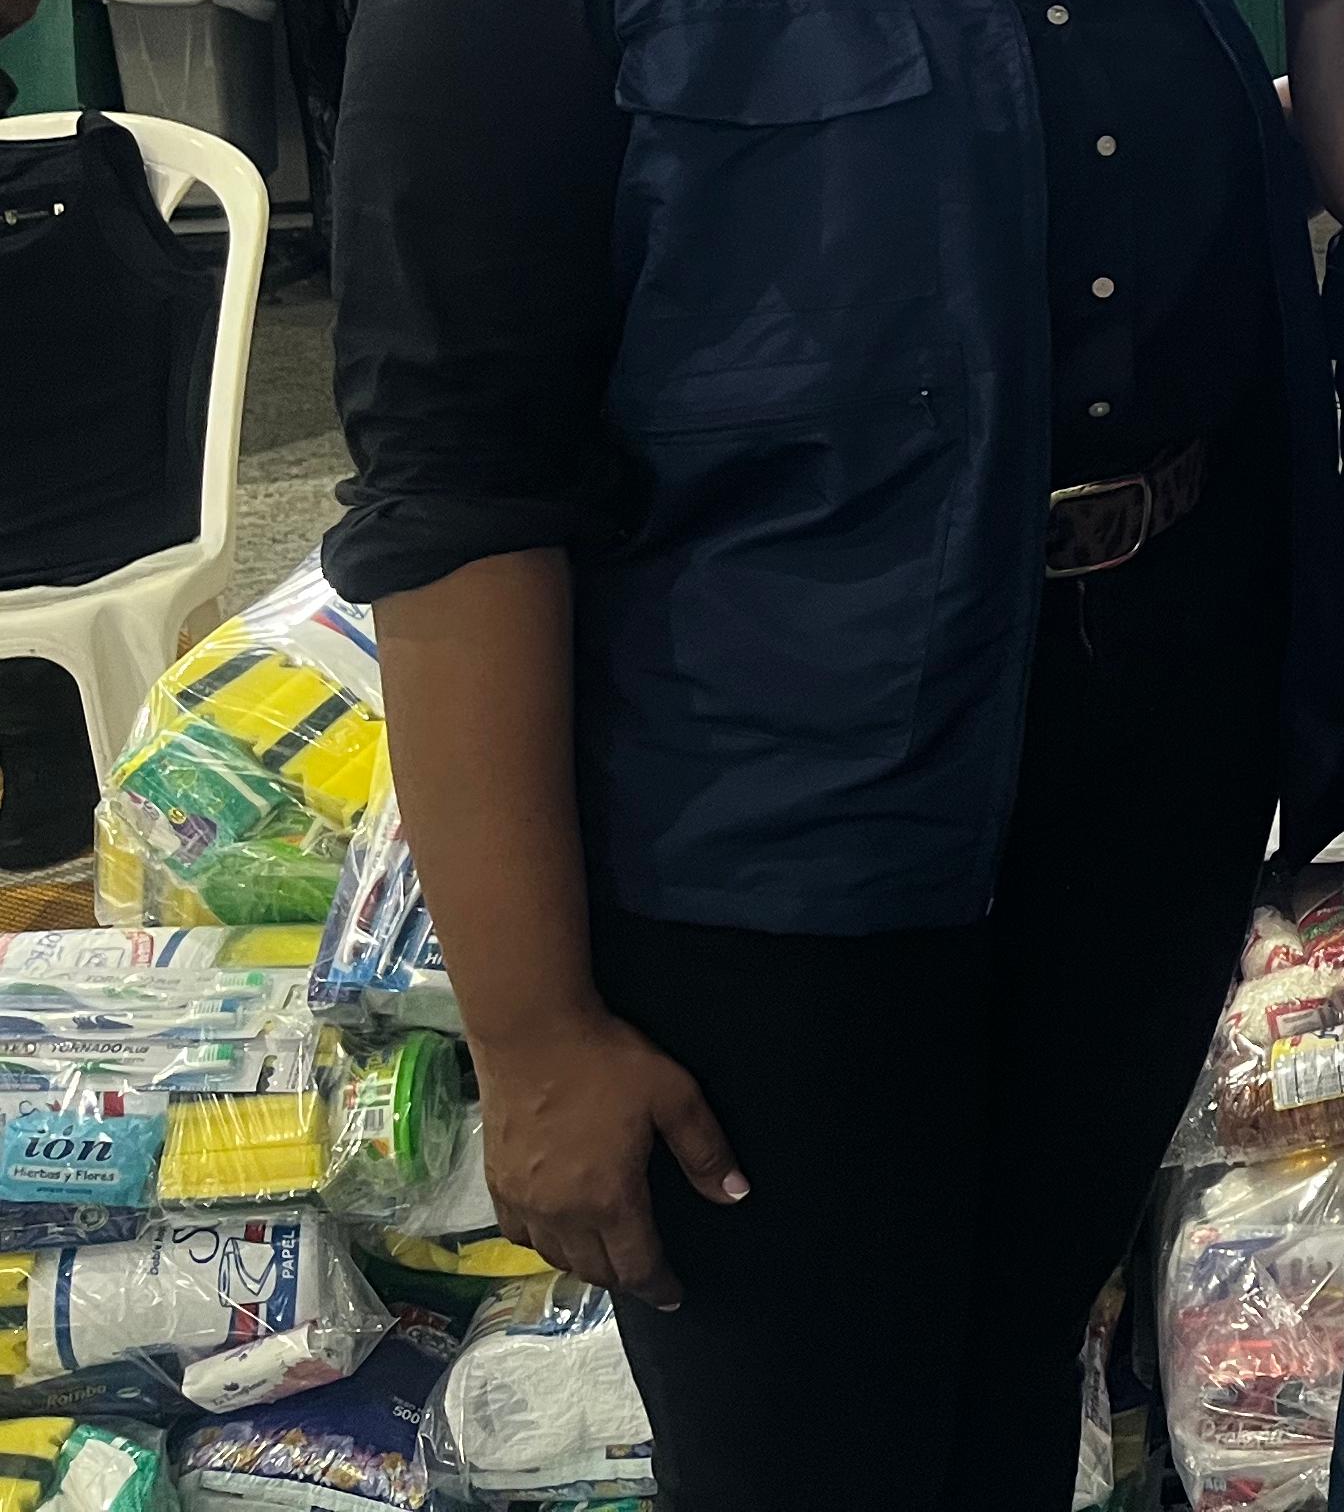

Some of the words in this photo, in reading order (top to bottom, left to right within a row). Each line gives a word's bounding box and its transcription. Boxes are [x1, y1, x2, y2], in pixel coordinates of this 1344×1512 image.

[51, 1041, 122, 1055] TORNADO
[122, 1045, 151, 1055] PLUS
[63, 1171, 73, 1184] y
[75, 1170, 117, 1182] Flores
[282, 1229, 297, 1280] PAPEL
[391, 1404, 421, 1425] 500
